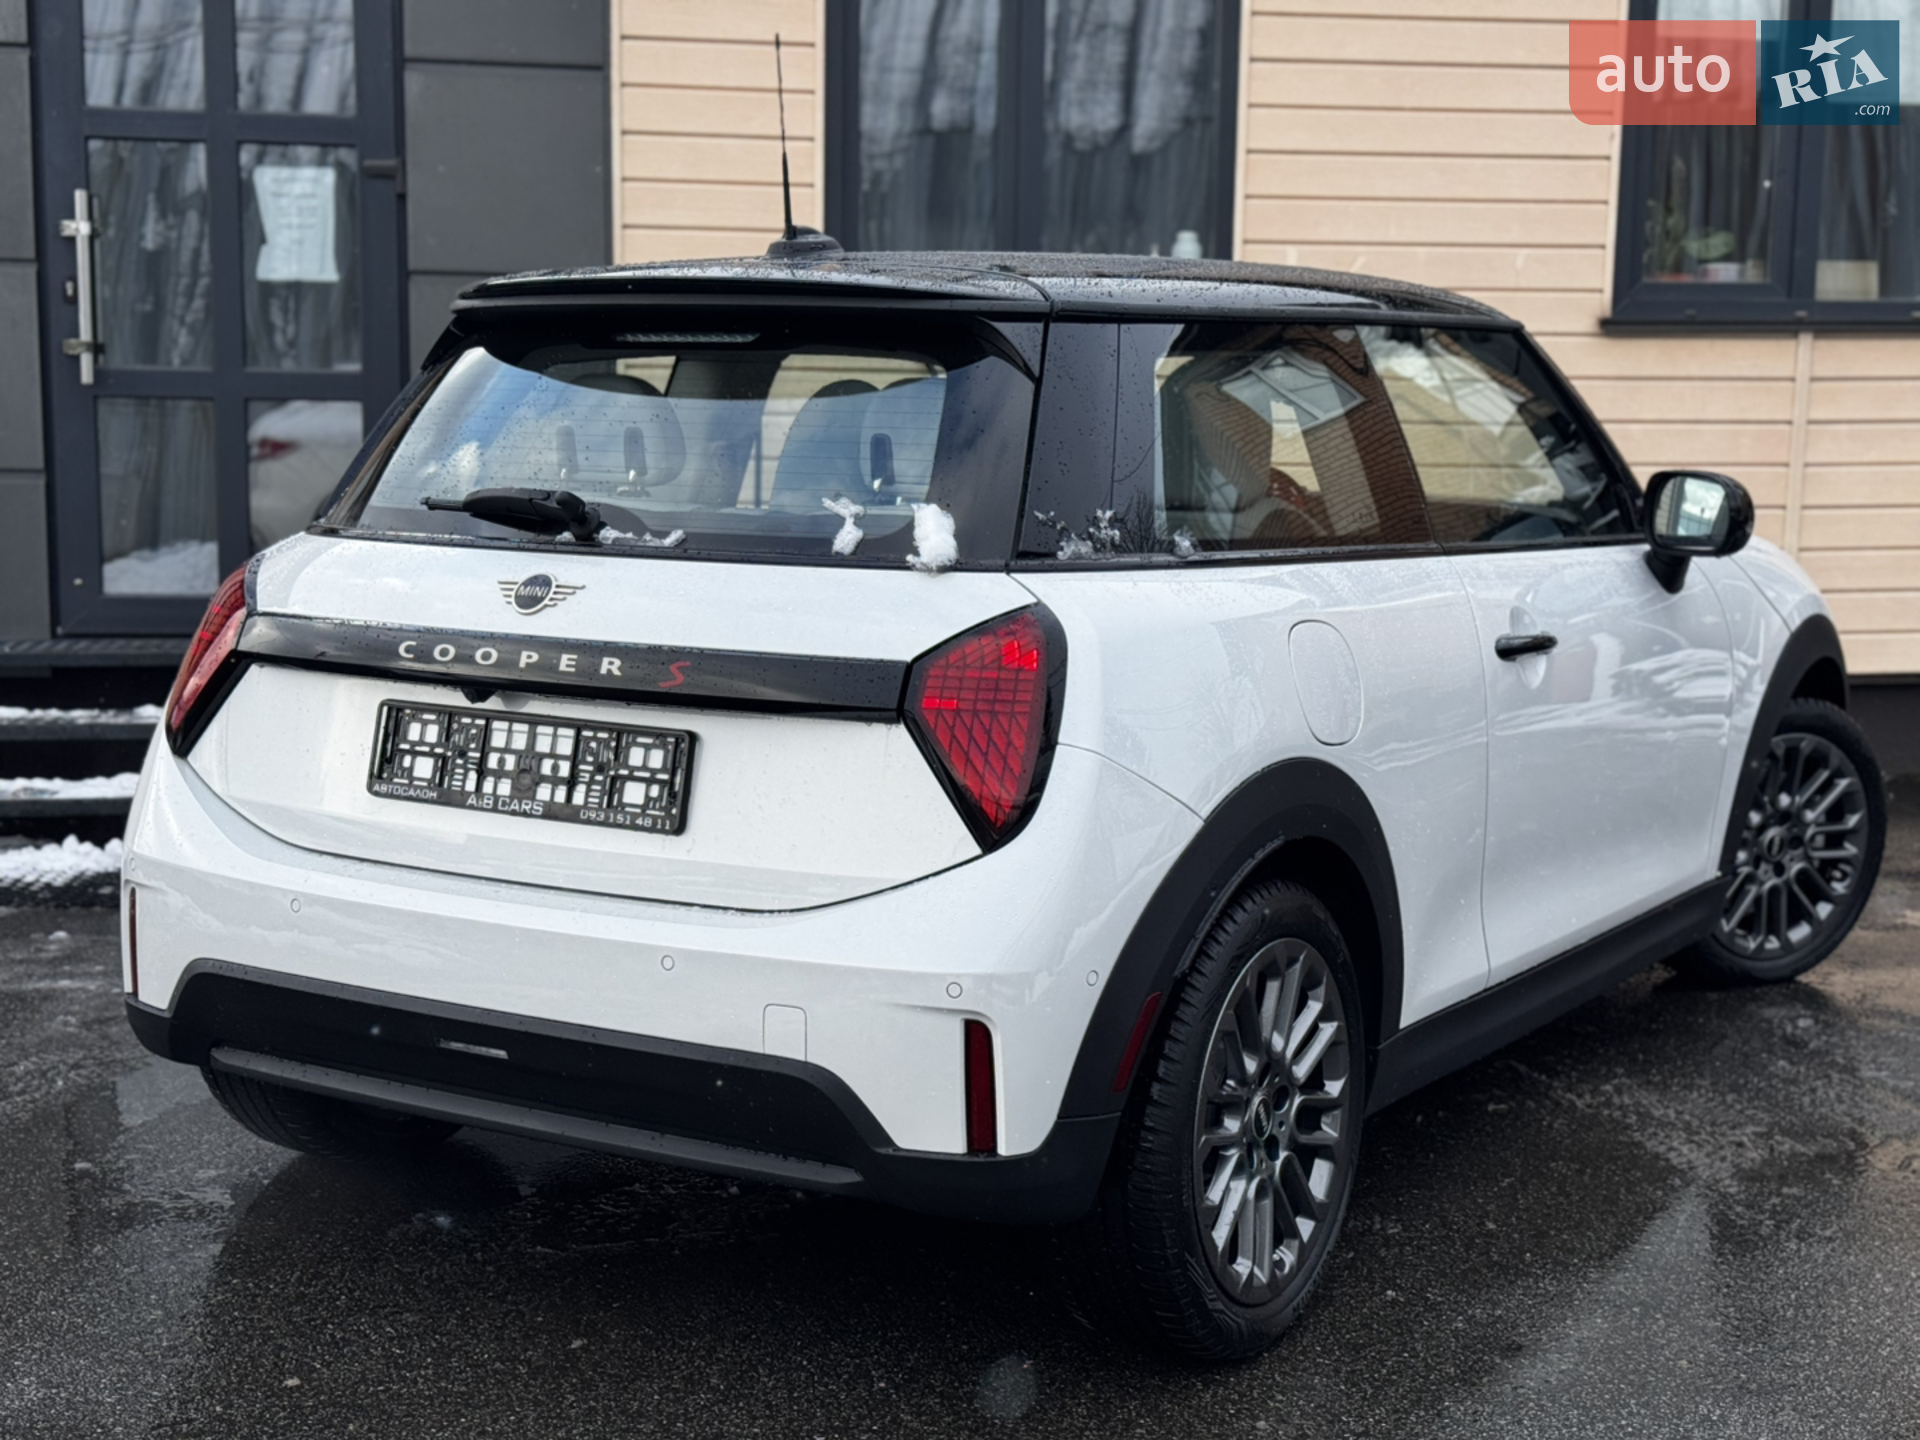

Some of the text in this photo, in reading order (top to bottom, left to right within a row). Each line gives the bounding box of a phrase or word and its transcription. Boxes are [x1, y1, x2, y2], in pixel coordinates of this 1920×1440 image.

[516, 584, 550, 598] MINI
[398, 640, 692, 689] COOPER S
[372, 782, 438, 800] АВТОСАЛОН
[497, 796, 544, 816] CARS
[580, 808, 671, 830] 093 151 48 11
